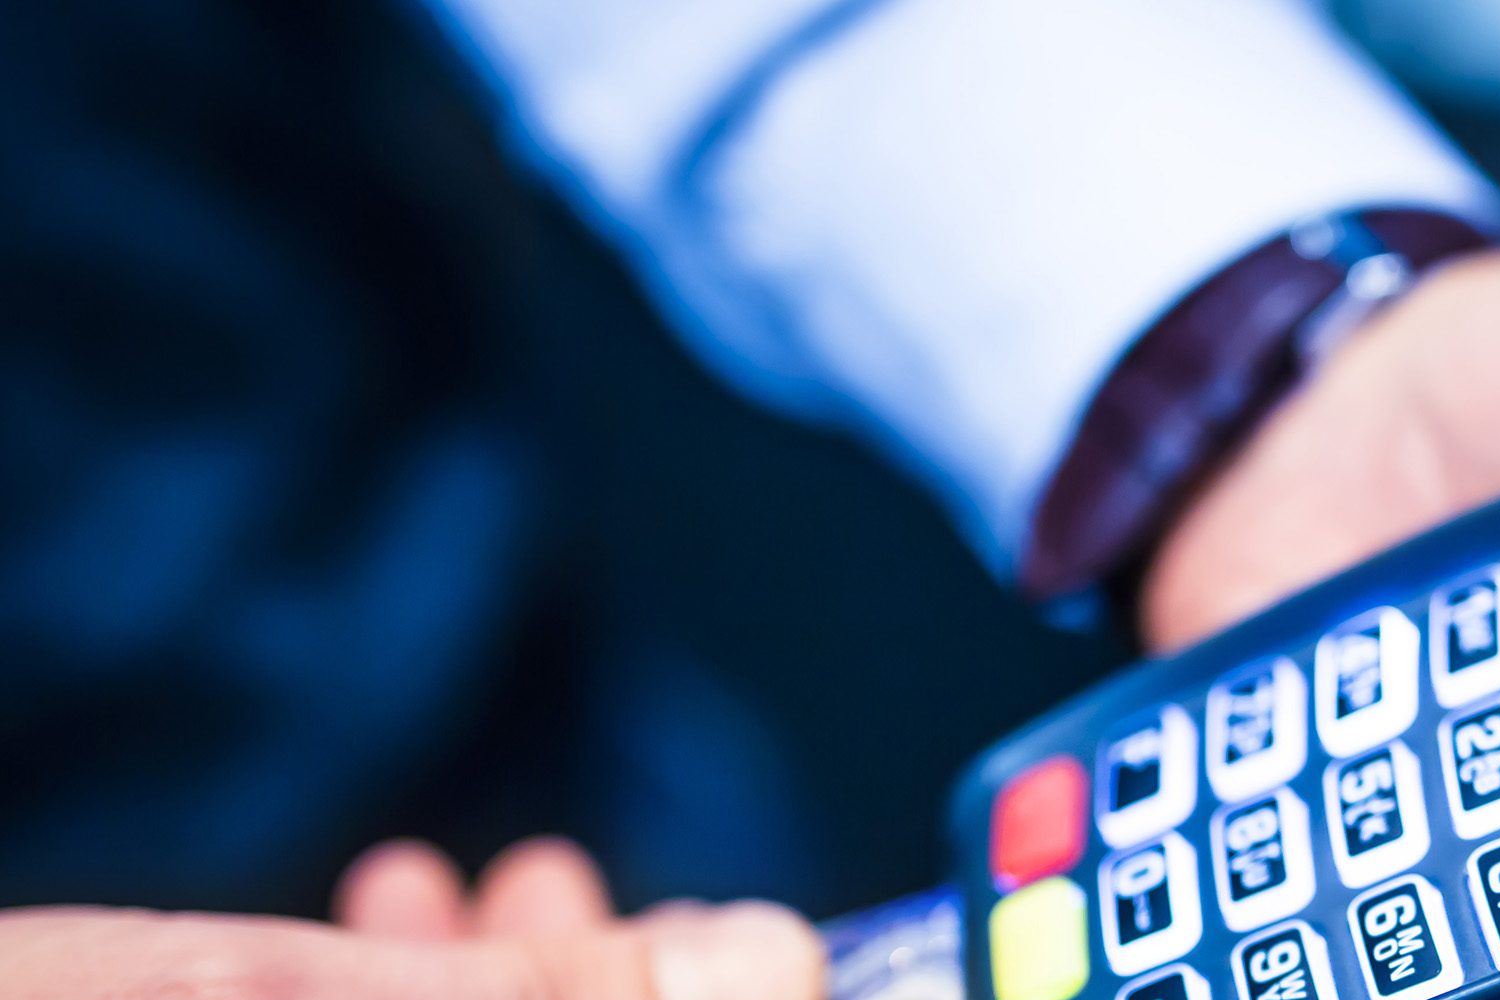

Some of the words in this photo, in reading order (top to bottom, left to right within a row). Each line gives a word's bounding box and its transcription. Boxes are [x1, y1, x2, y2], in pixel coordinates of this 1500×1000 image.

[1341, 759, 1393, 803] 5
[1226, 807, 1278, 851] 8
[1114, 851, 1166, 897] 0
[1365, 894, 1417, 937] 6
[1250, 940, 1301, 984] 9
